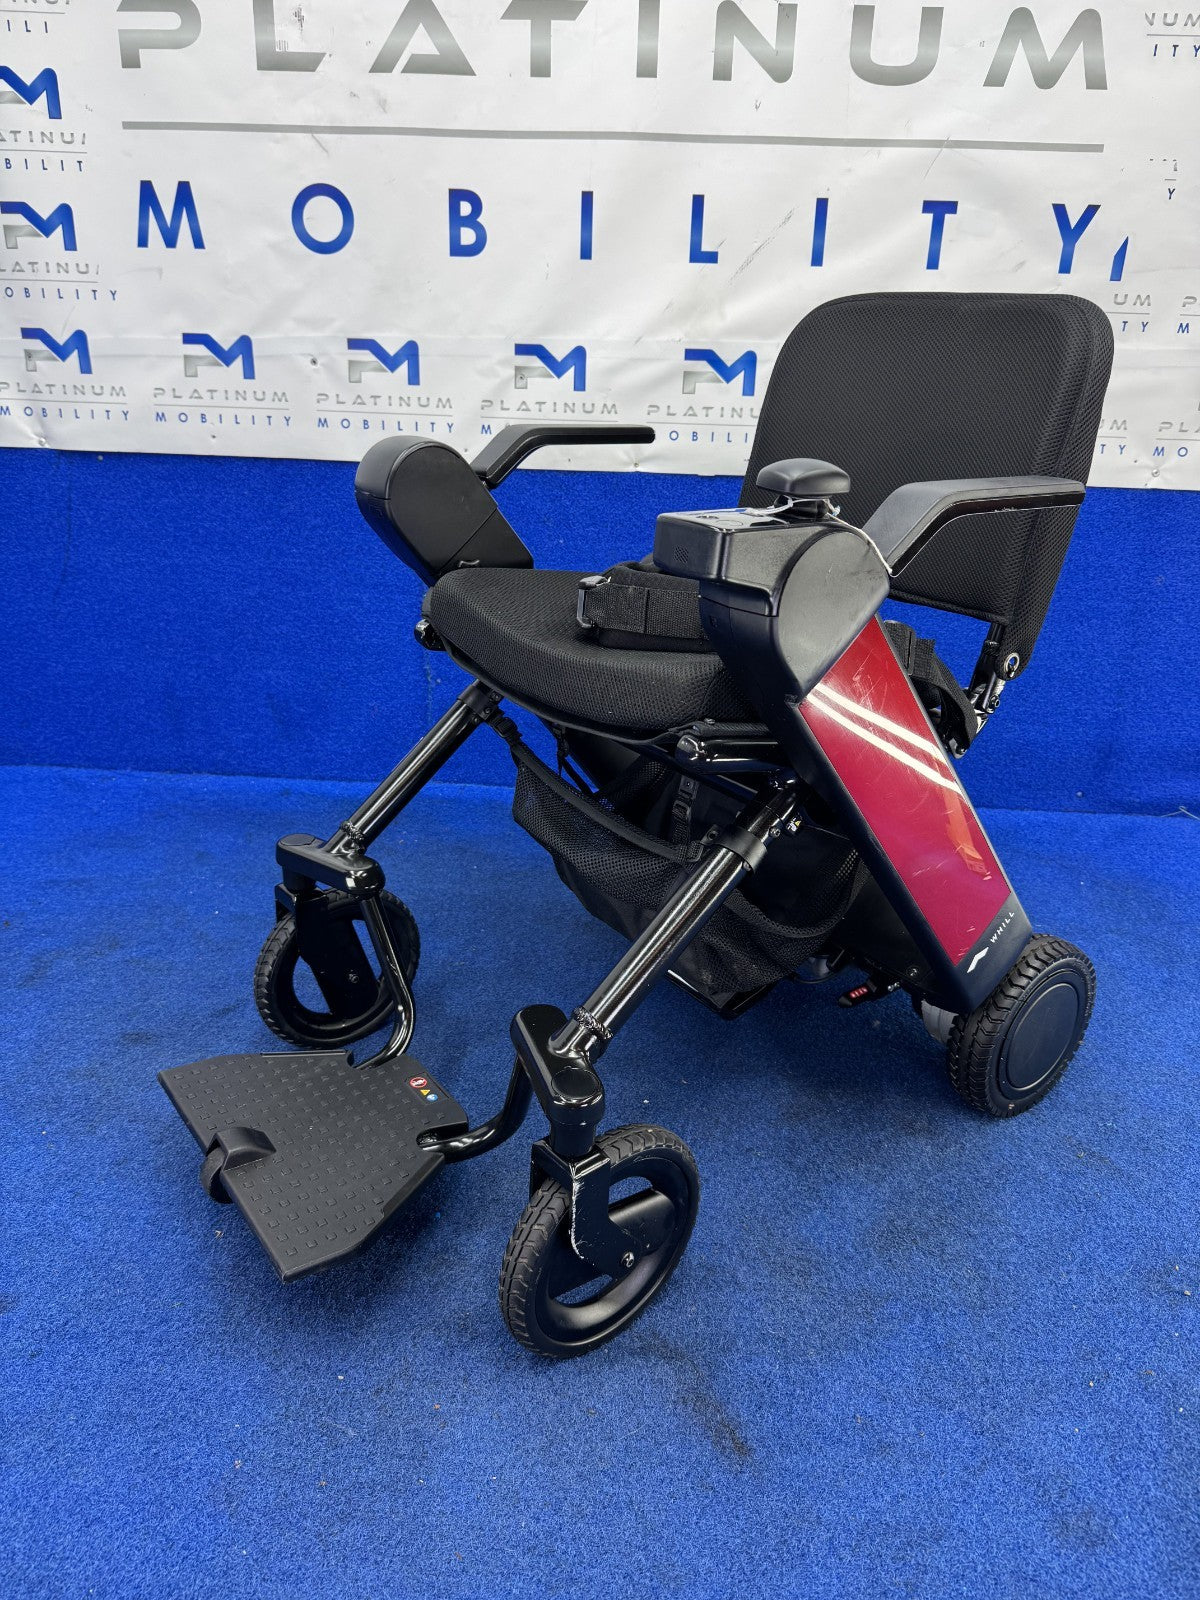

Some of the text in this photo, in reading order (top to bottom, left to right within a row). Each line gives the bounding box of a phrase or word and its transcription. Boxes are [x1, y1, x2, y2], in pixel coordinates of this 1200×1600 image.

[115, 0, 1108, 90] PLATINUM
[136, 180, 1101, 275] MOBILITY
[0, 381, 127, 398] PLATINUM
[153, 387, 289, 403] PLATINUM
[316, 392, 453, 409] PLATINUM
[480, 399, 618, 415] PLATINUM
[0, 406, 129, 421] MOBILITY
[155, 412, 291, 426] MOBILITY
[317, 417, 454, 433] MOBILITY
[990, 912, 1015, 943] WHILL
